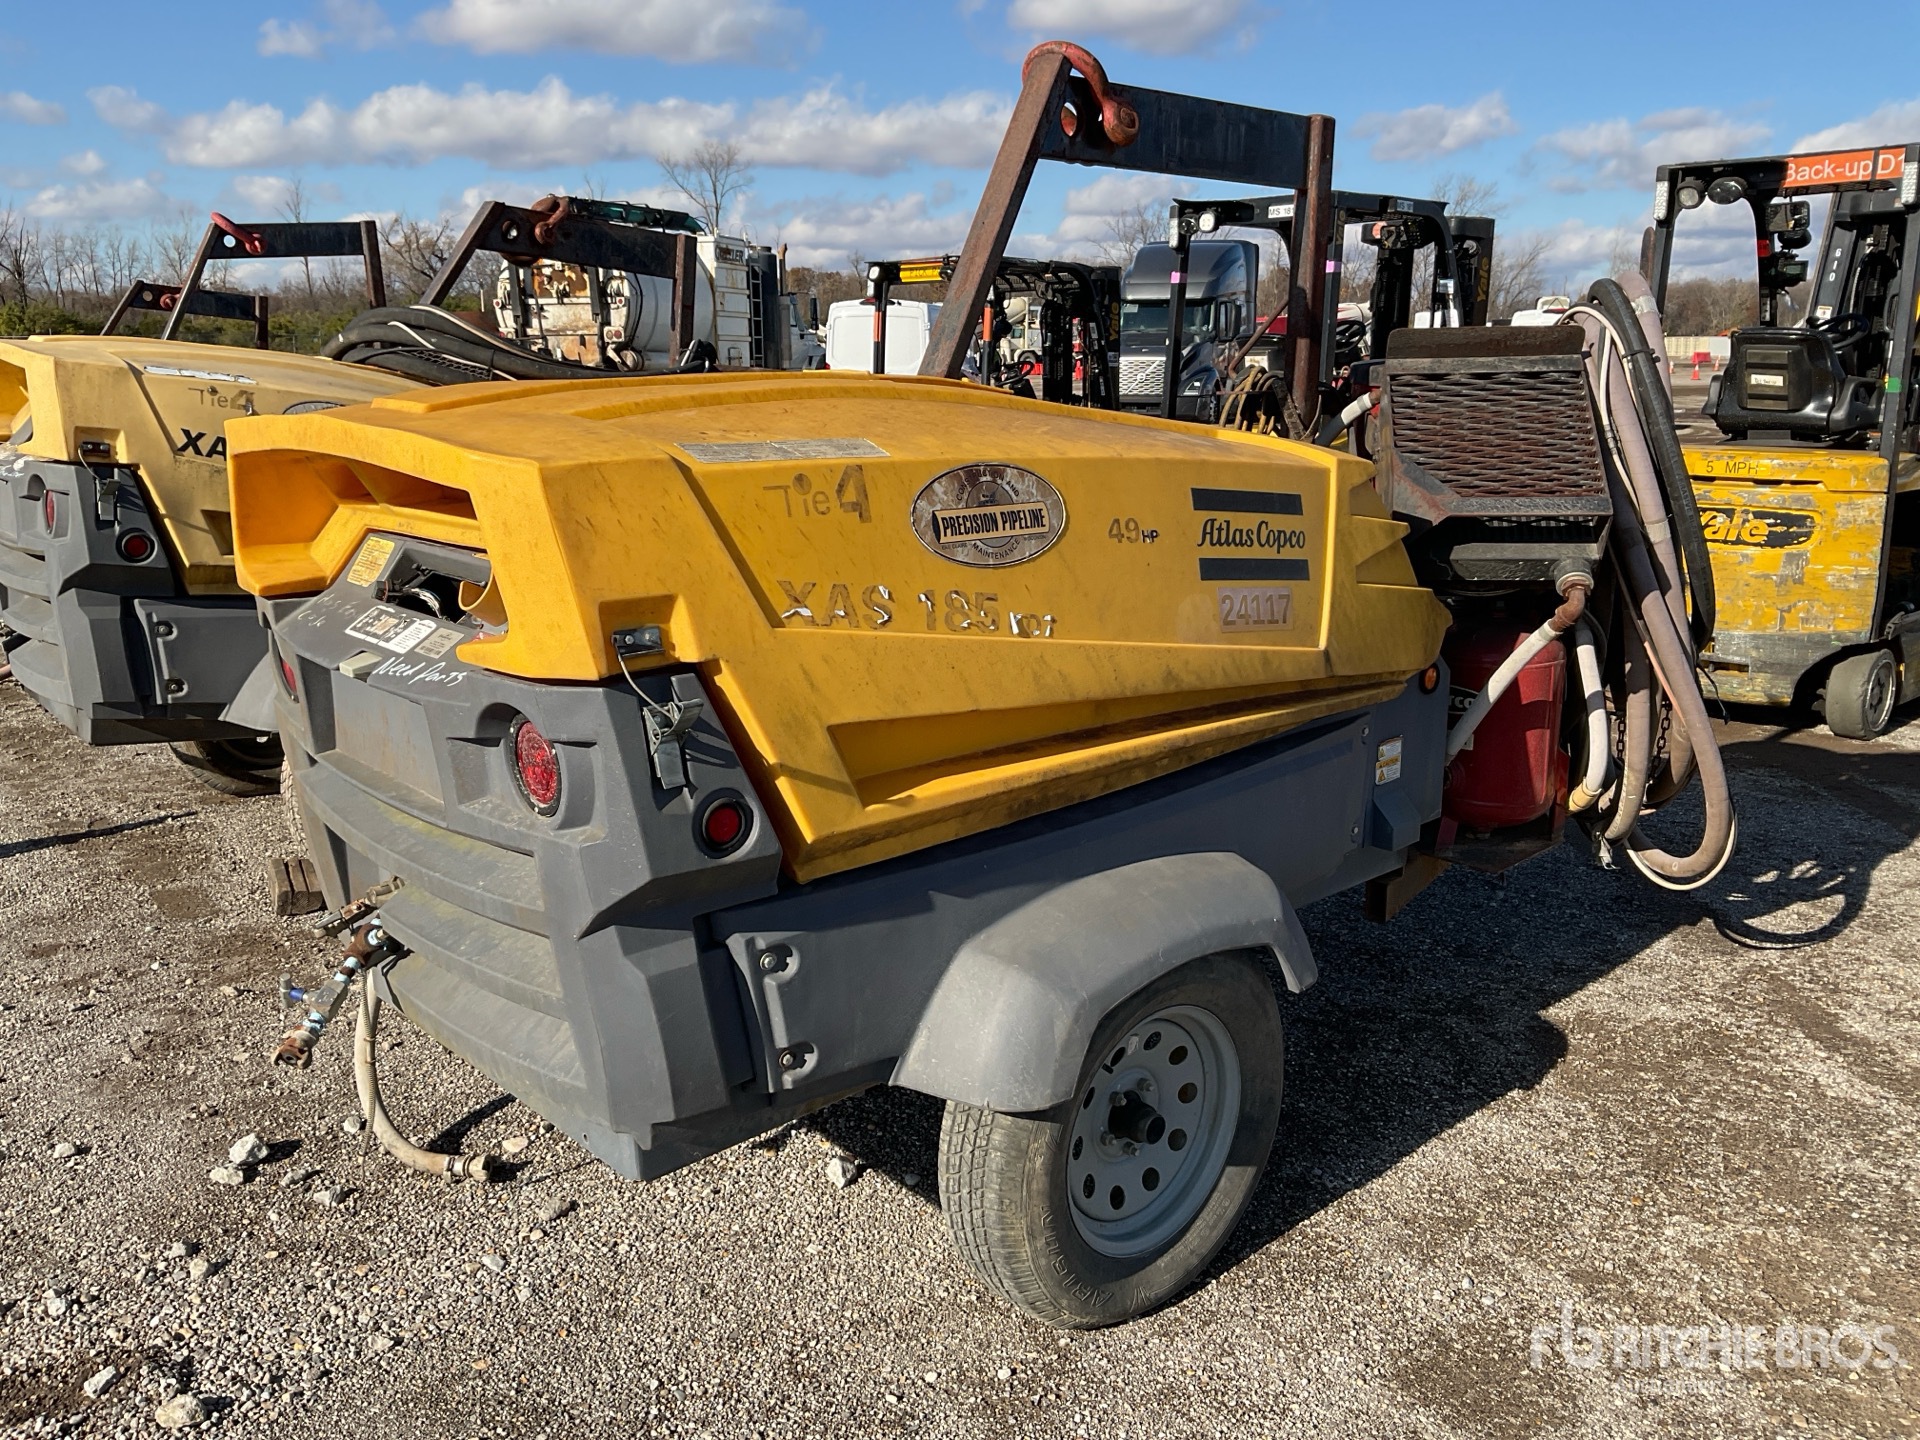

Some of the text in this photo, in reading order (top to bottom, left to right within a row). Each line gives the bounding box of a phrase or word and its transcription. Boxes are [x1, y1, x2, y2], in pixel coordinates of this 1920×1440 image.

[1477, 256, 1489, 302] Yale
[1109, 302, 1120, 341] Yale
[1706, 460, 1759, 475] 5 MPH
[941, 508, 1046, 537] PRECISION PIPELINE
[1197, 518, 1306, 554] Atlas Copco
[1700, 508, 1769, 543] ale
[971, 538, 1021, 560] MAINTENANCE
[777, 579, 896, 630] XAS
[918, 588, 1000, 632] 185
[1221, 594, 1291, 626] 24117
[372, 656, 426, 676] Need
